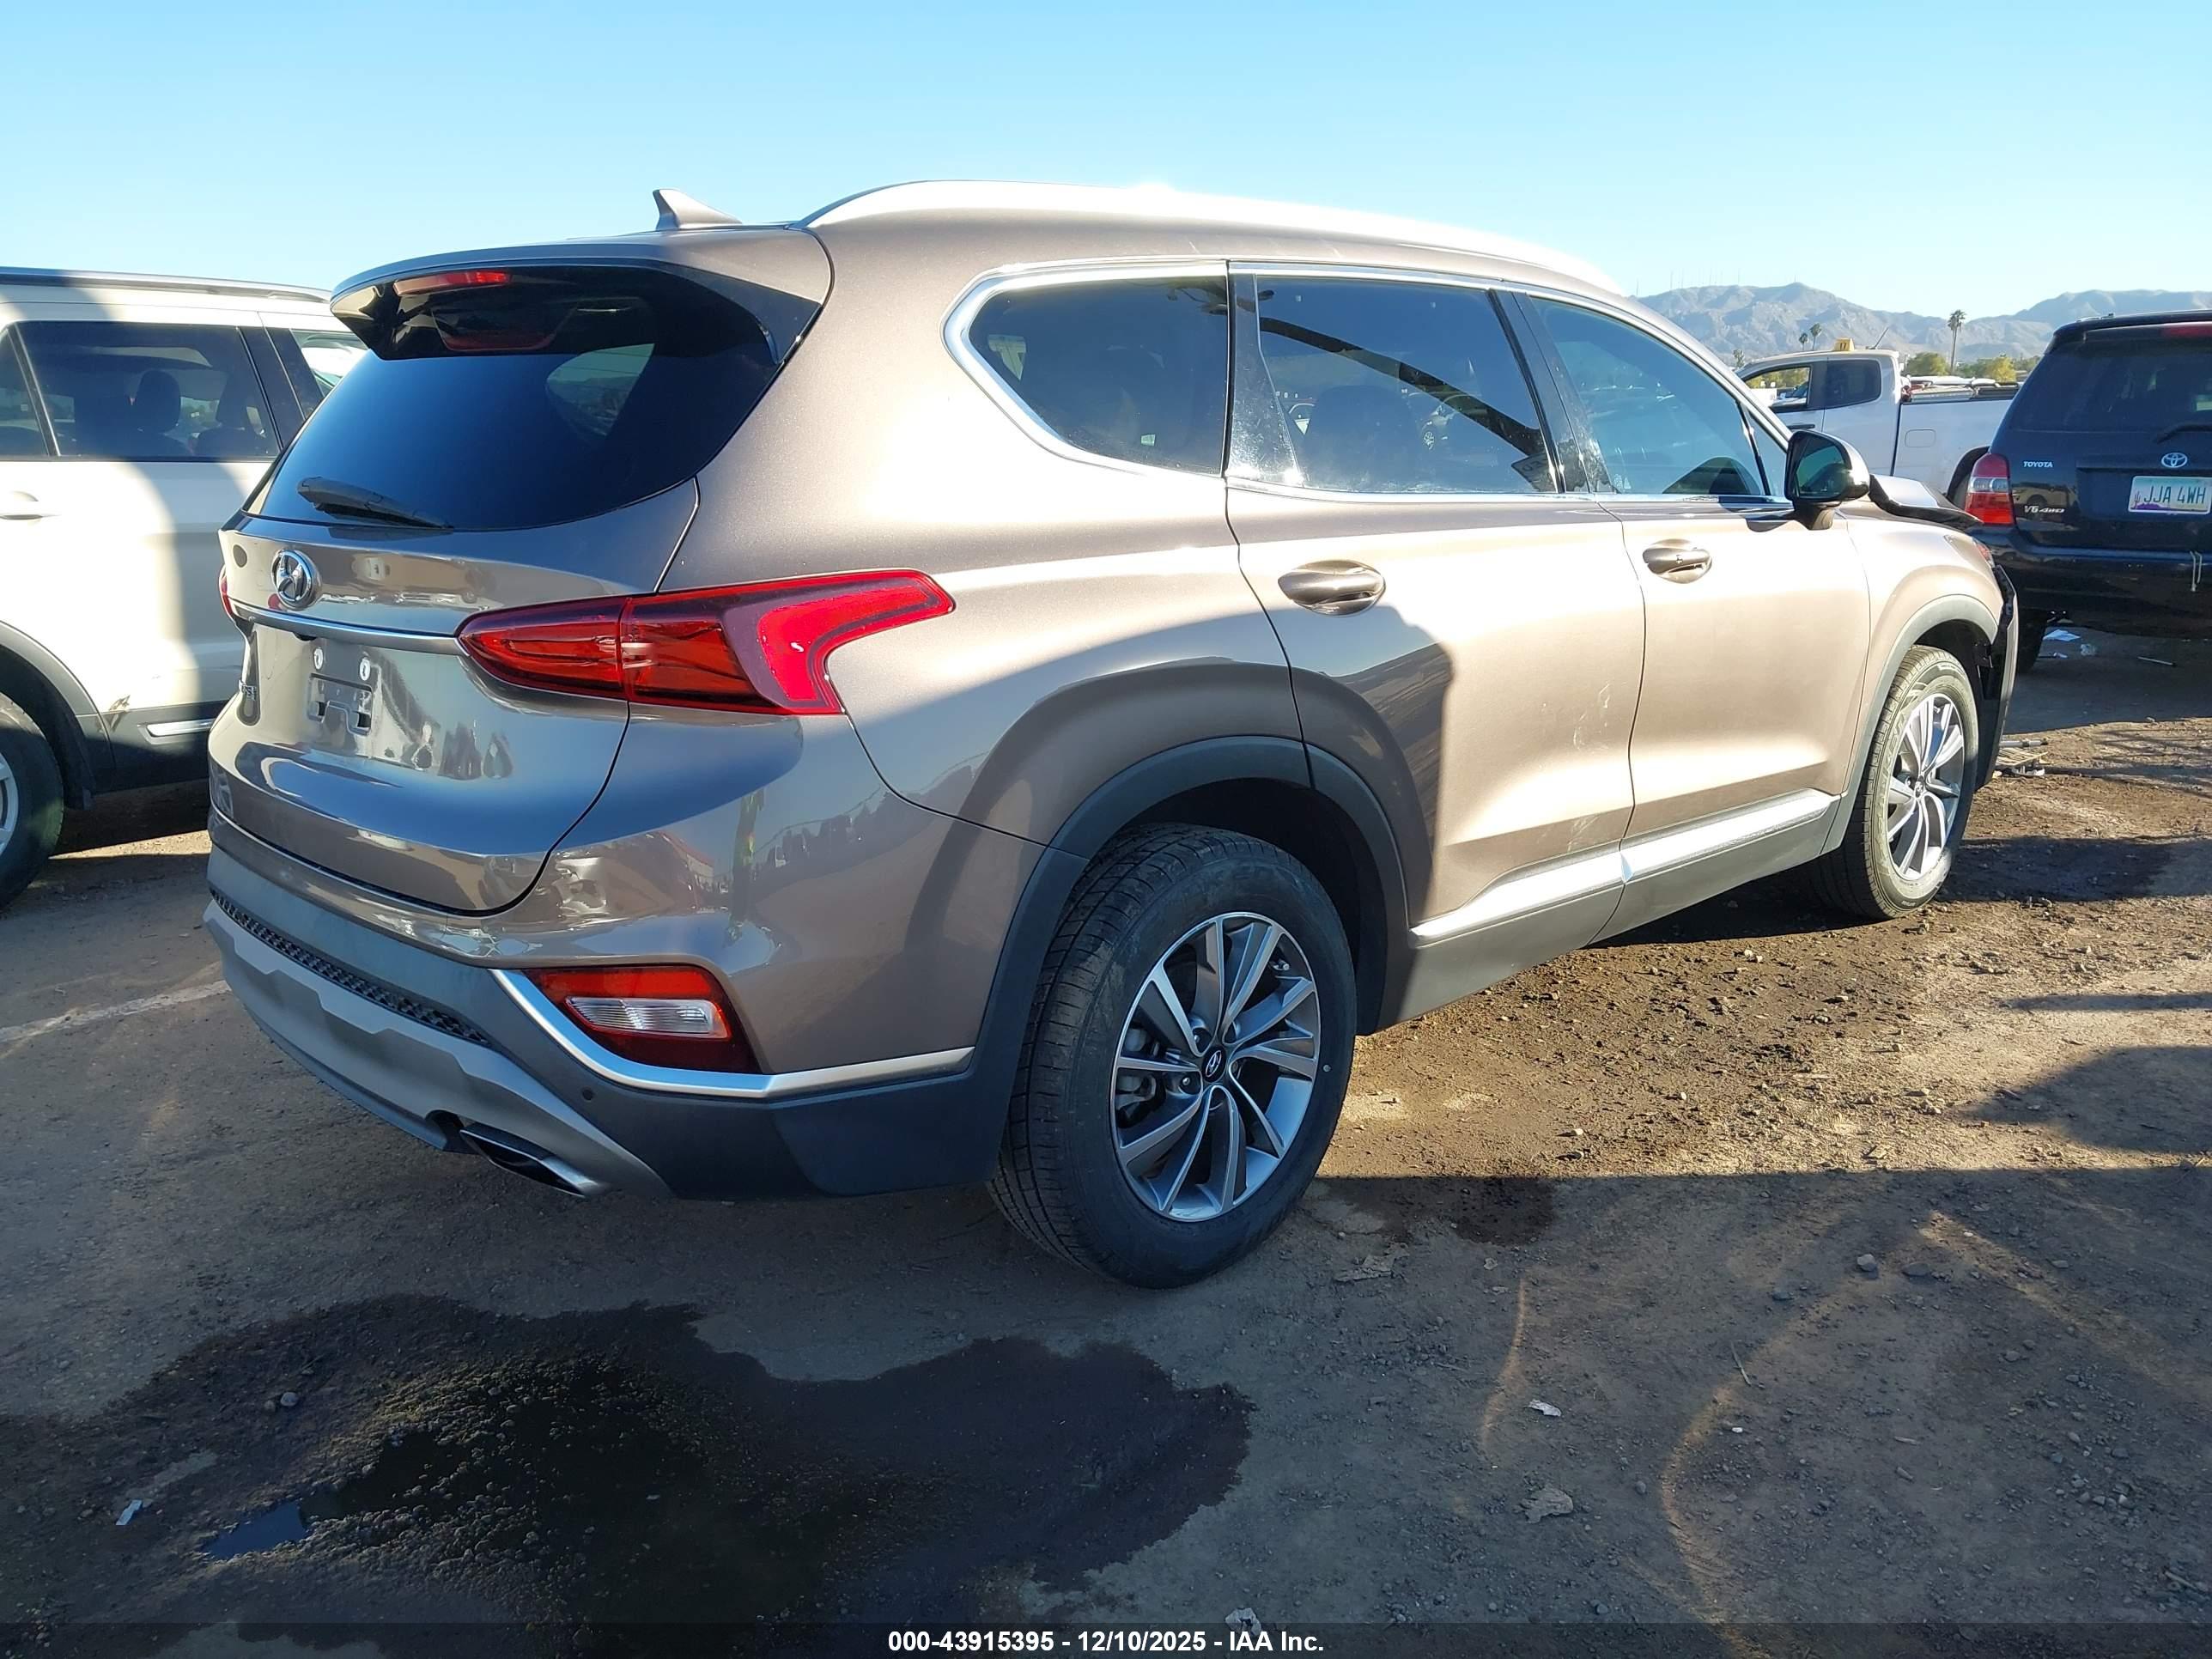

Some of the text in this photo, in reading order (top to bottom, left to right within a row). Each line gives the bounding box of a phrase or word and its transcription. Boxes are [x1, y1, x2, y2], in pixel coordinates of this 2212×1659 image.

[2143, 485, 2206, 504] JJA 4WH
[2024, 505, 2039, 514] V6
